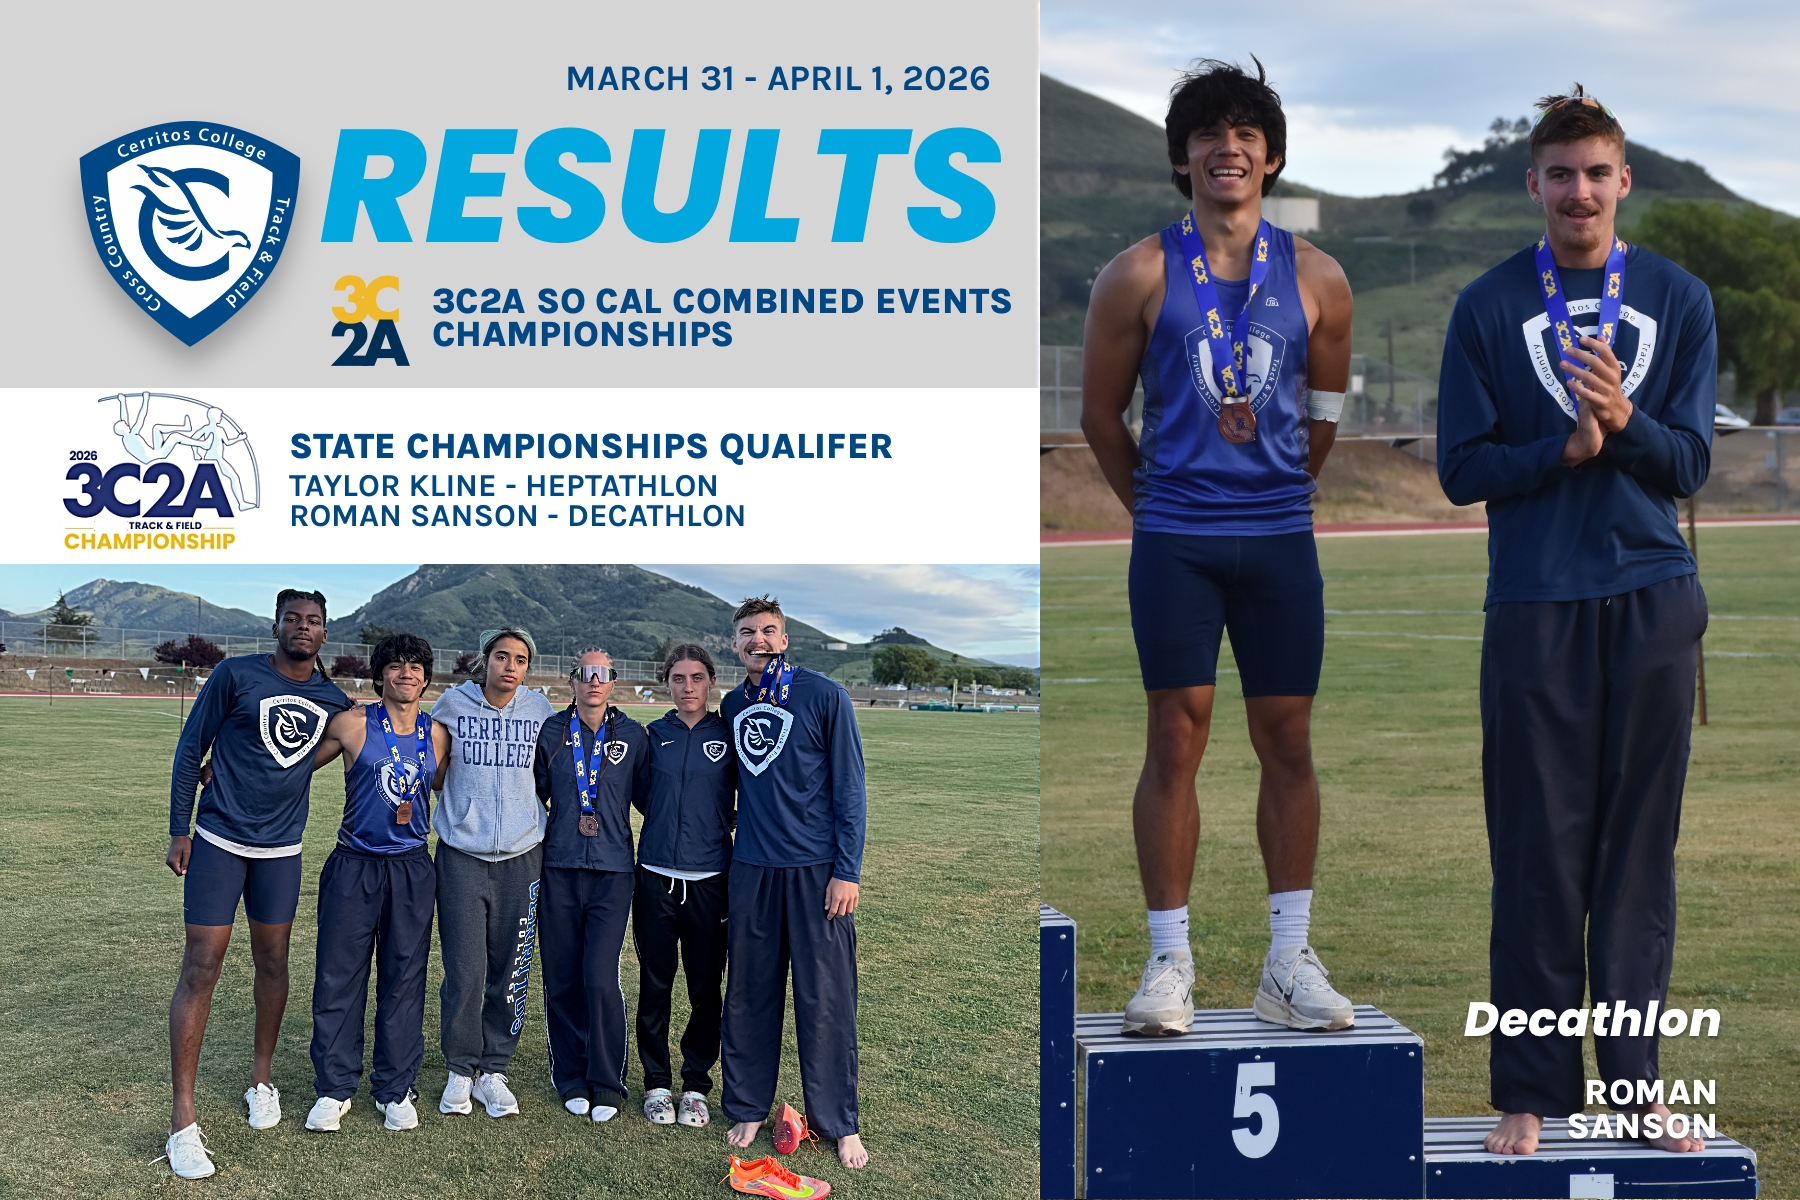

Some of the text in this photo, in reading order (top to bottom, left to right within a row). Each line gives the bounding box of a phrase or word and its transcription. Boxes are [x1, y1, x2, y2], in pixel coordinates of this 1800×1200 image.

[1256, 237, 1269, 262] 3C2A
[1191, 255, 1209, 284] 3C2A
[1542, 269, 1557, 299] 3C2A
[1607, 272, 1620, 299] 3C2A
[1207, 307, 1224, 339] 3C2A
[1249, 326, 1271, 341] llege
[1555, 320, 1573, 351] 3C2A
[1636, 342, 1652, 369] Track
[1191, 354, 1221, 412] Cross Country
[1221, 365, 1239, 397] 3C2A
[1268, 359, 1280, 382] Track
[1533, 344, 1575, 412] Cross Country
[1249, 391, 1268, 411] Field
[1621, 381, 1635, 395] Fie
[457, 715, 540, 744] CERRITOS
[462, 740, 534, 769] COLLEGE
[506, 917, 528, 1004] COLLEGE
[1231, 1062, 1280, 1159] 5
